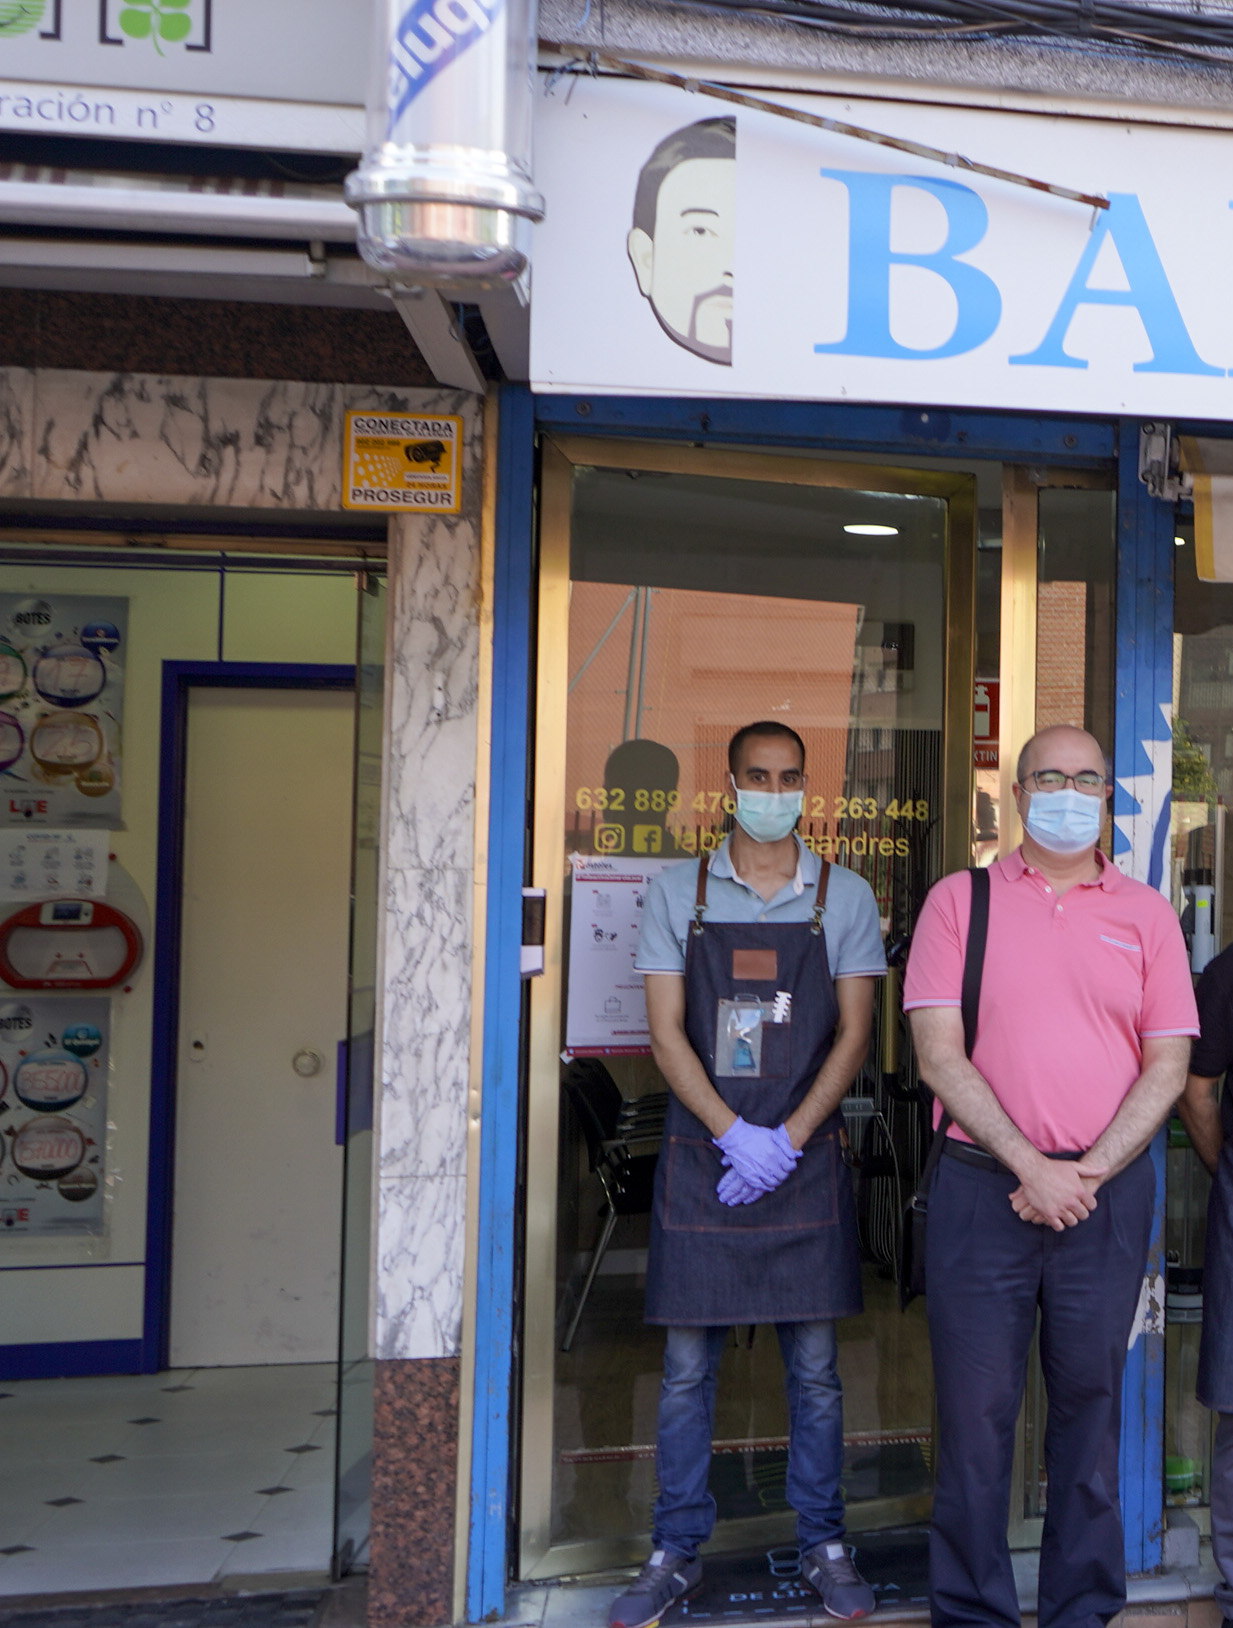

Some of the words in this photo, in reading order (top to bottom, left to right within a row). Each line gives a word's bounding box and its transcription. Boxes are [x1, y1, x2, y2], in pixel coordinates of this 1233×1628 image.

[194, 102, 216, 133] 8
[354, 418, 454, 433] CONECTADA
[351, 488, 453, 505] PROSEGUR
[575, 786, 625, 811] 632
[634, 788, 682, 812] 889
[692, 791, 737, 815] 476
[801, 796, 825, 818] 12
[833, 799, 878, 820] 263
[884, 798, 929, 821] 448
